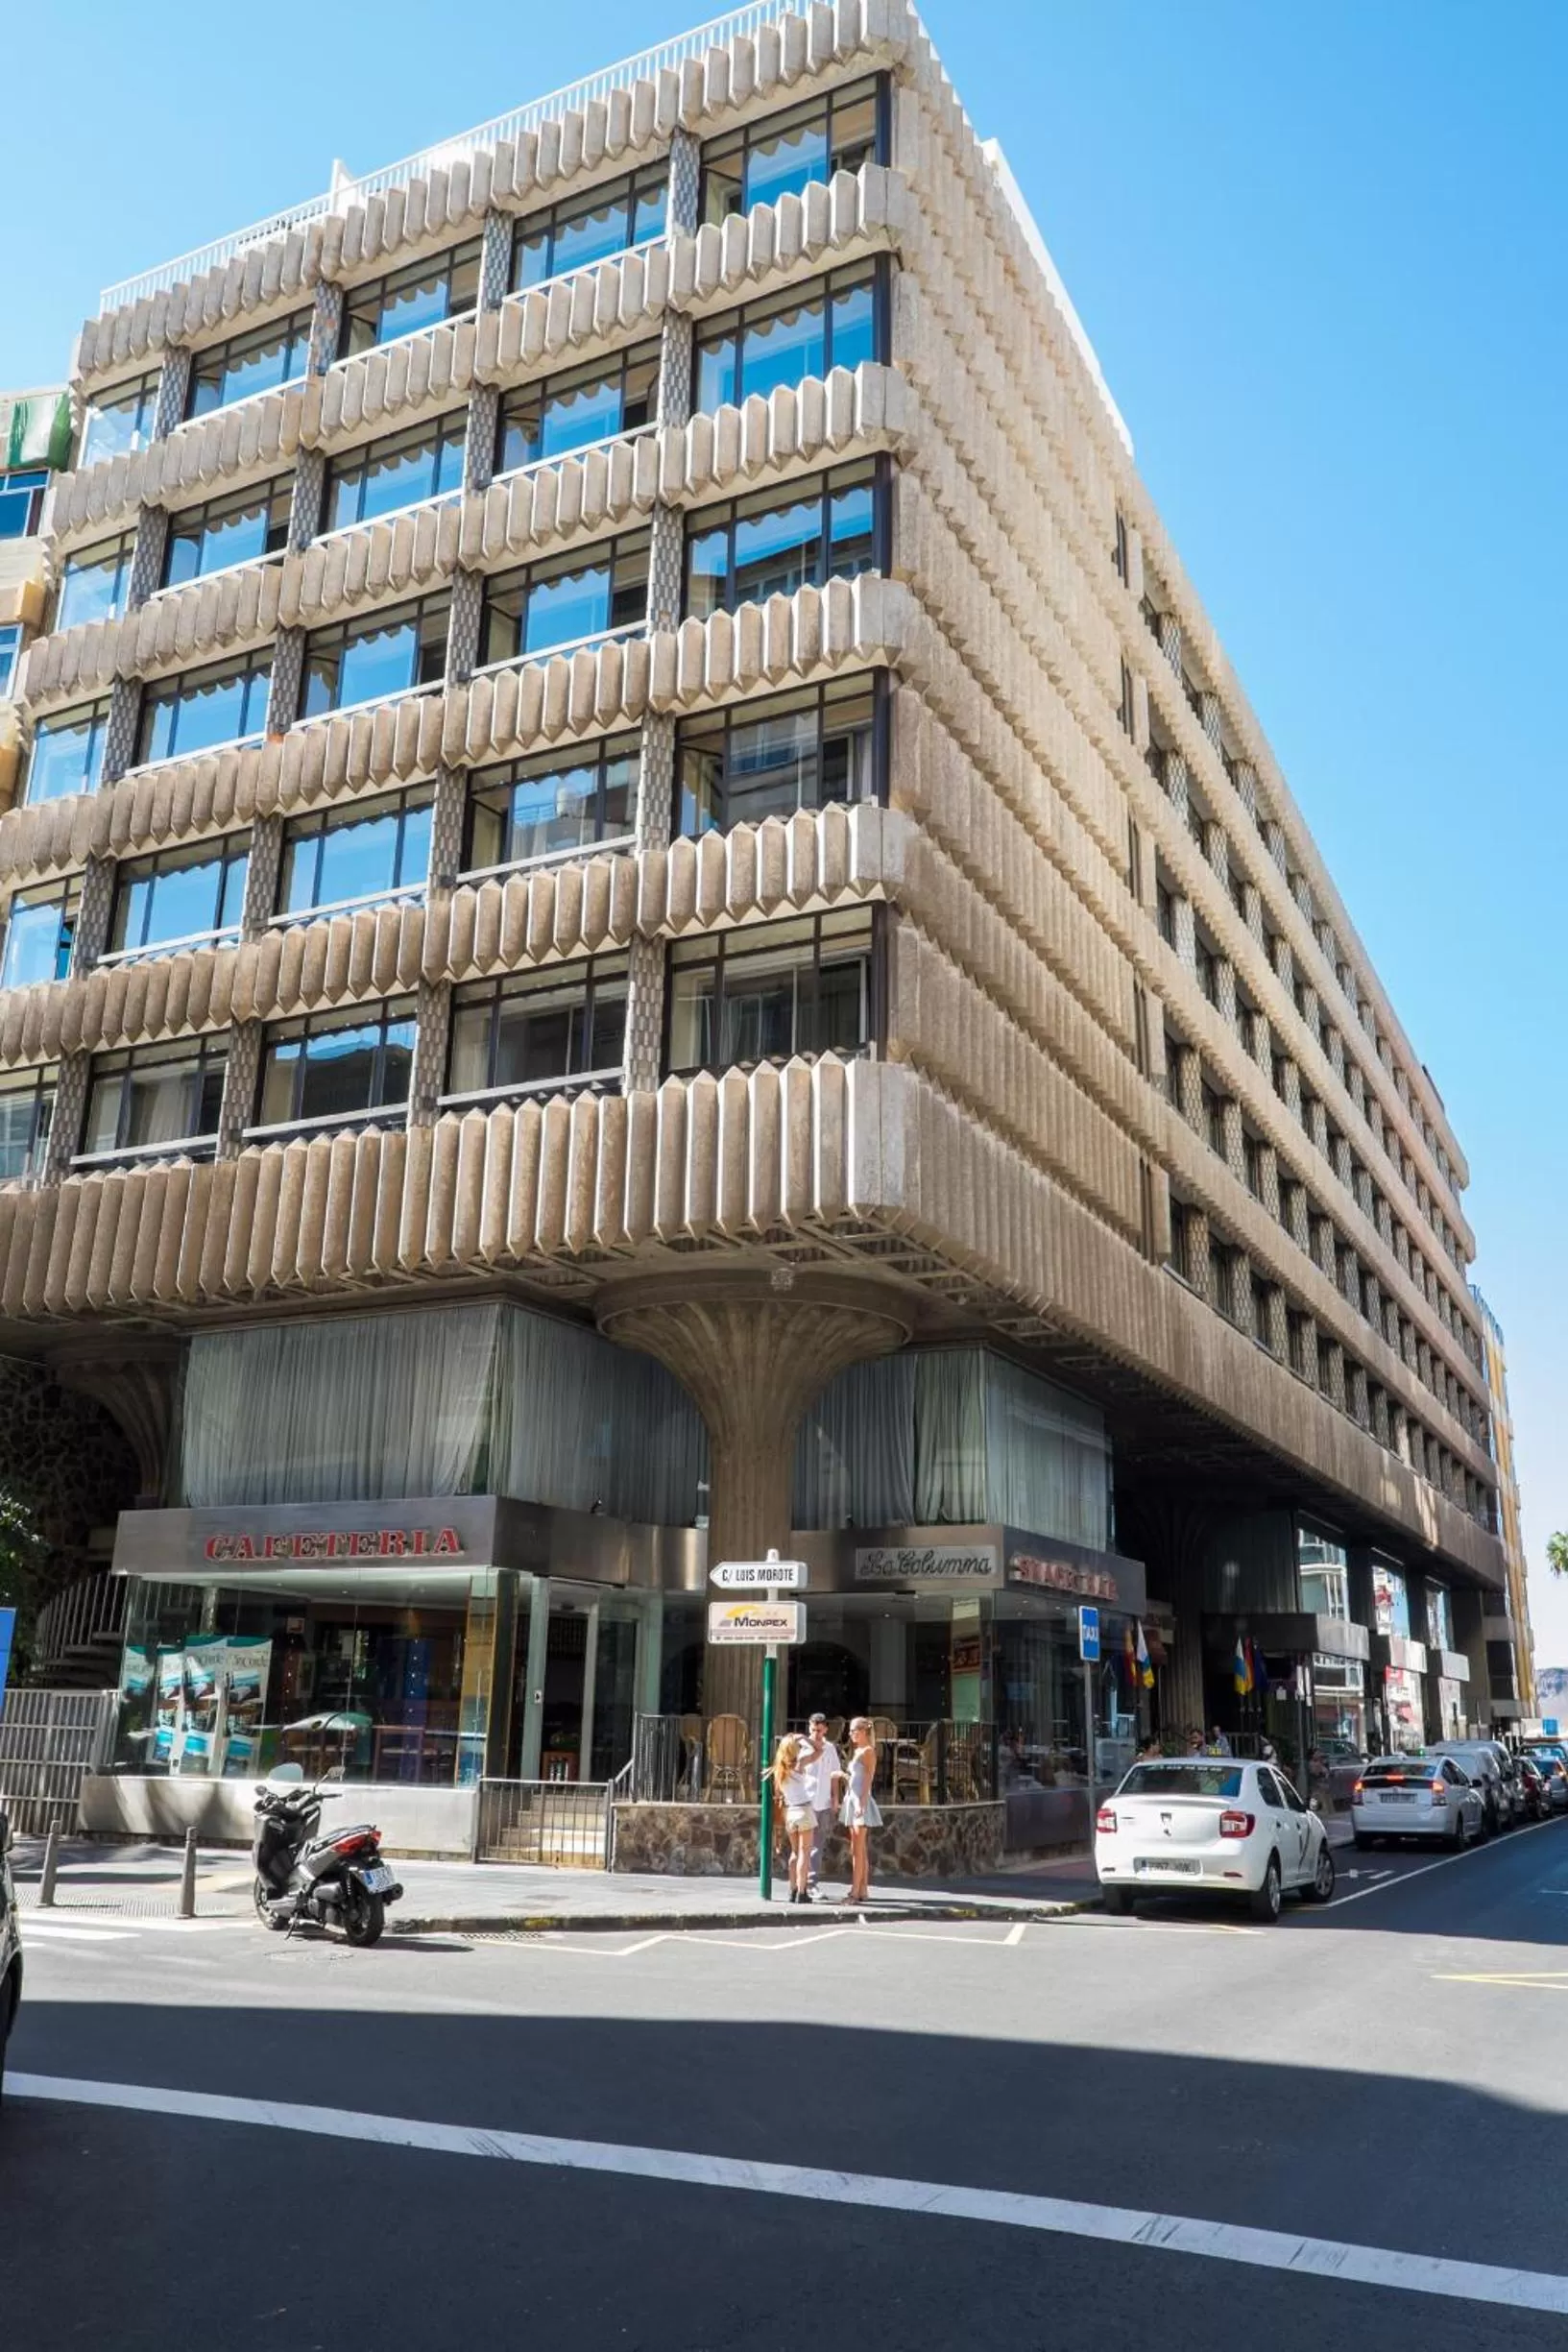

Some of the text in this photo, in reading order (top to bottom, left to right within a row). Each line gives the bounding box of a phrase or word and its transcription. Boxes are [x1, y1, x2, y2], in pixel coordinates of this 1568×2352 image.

[204, 1528, 465, 1562] CAFETERIA
[722, 1568, 794, 1583] C/ LUIS MOROTE
